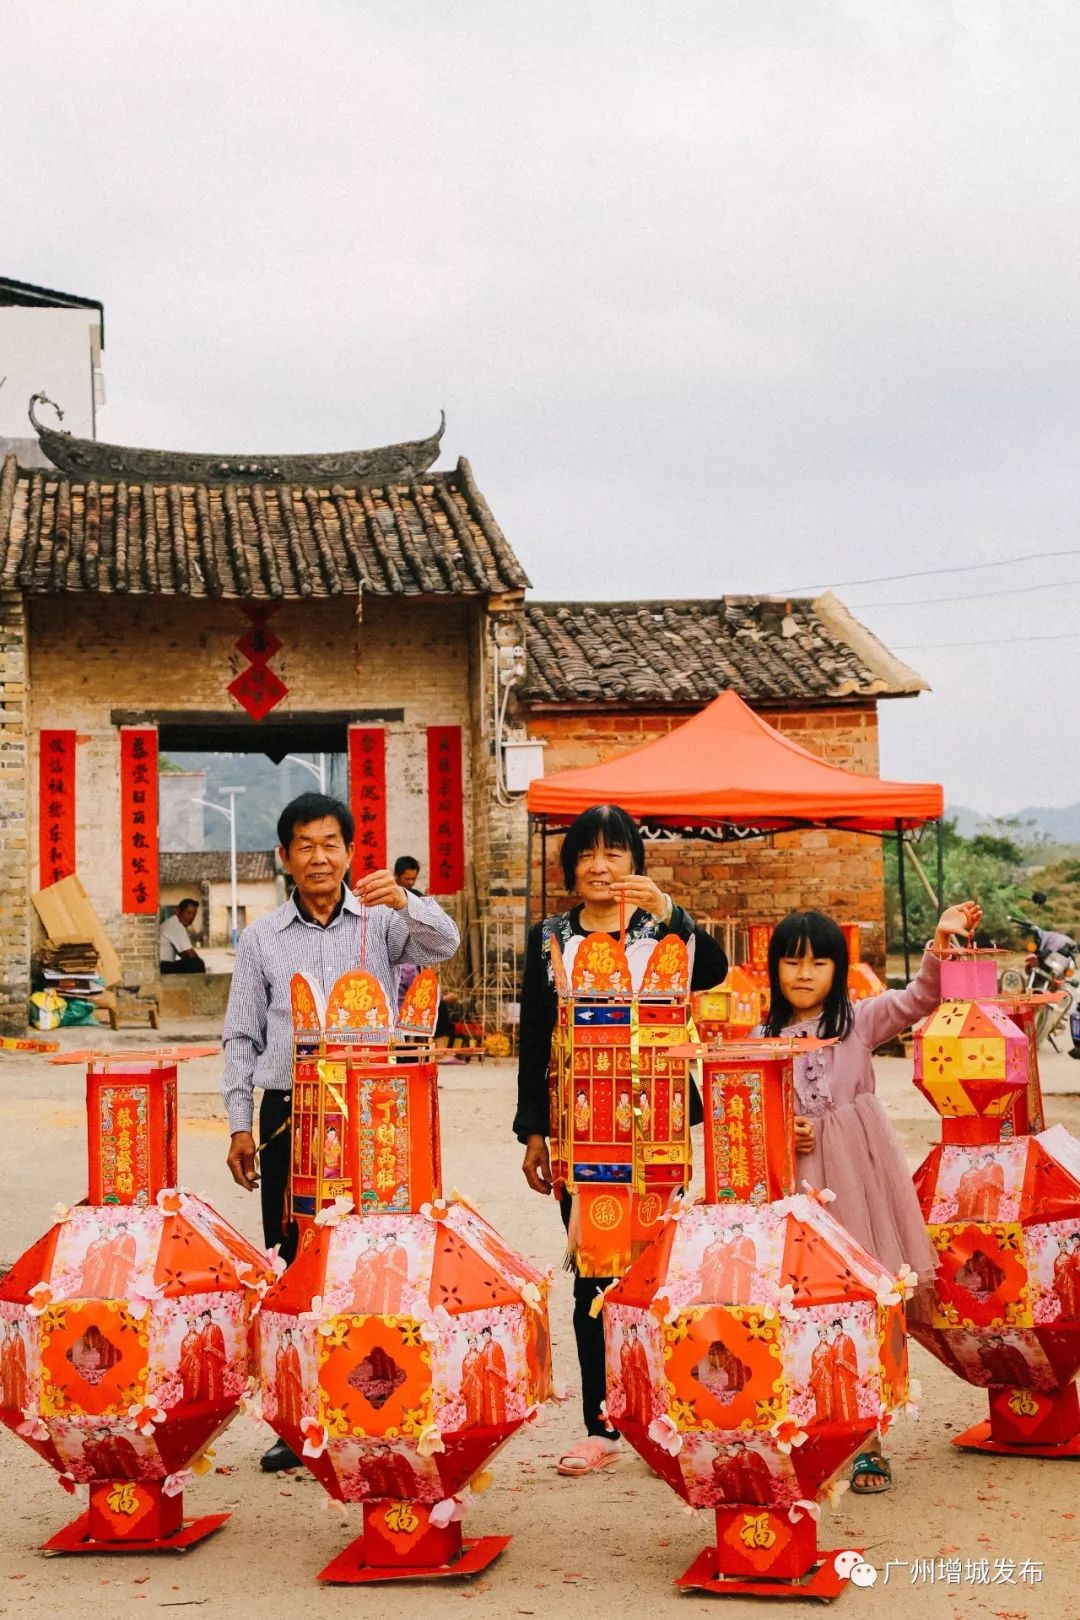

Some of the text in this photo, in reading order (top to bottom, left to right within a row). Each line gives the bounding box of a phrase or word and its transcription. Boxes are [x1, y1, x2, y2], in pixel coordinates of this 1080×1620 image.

[587, 942, 616, 974] 福
[656, 943, 680, 975] 福
[343, 978, 373, 1011] 福
[413, 979, 434, 1009] 福
[1009, 1389, 1039, 1416] 福
[106, 1482, 139, 1515] 福
[383, 1503, 419, 1534] 福
[740, 1512, 777, 1549] 福
